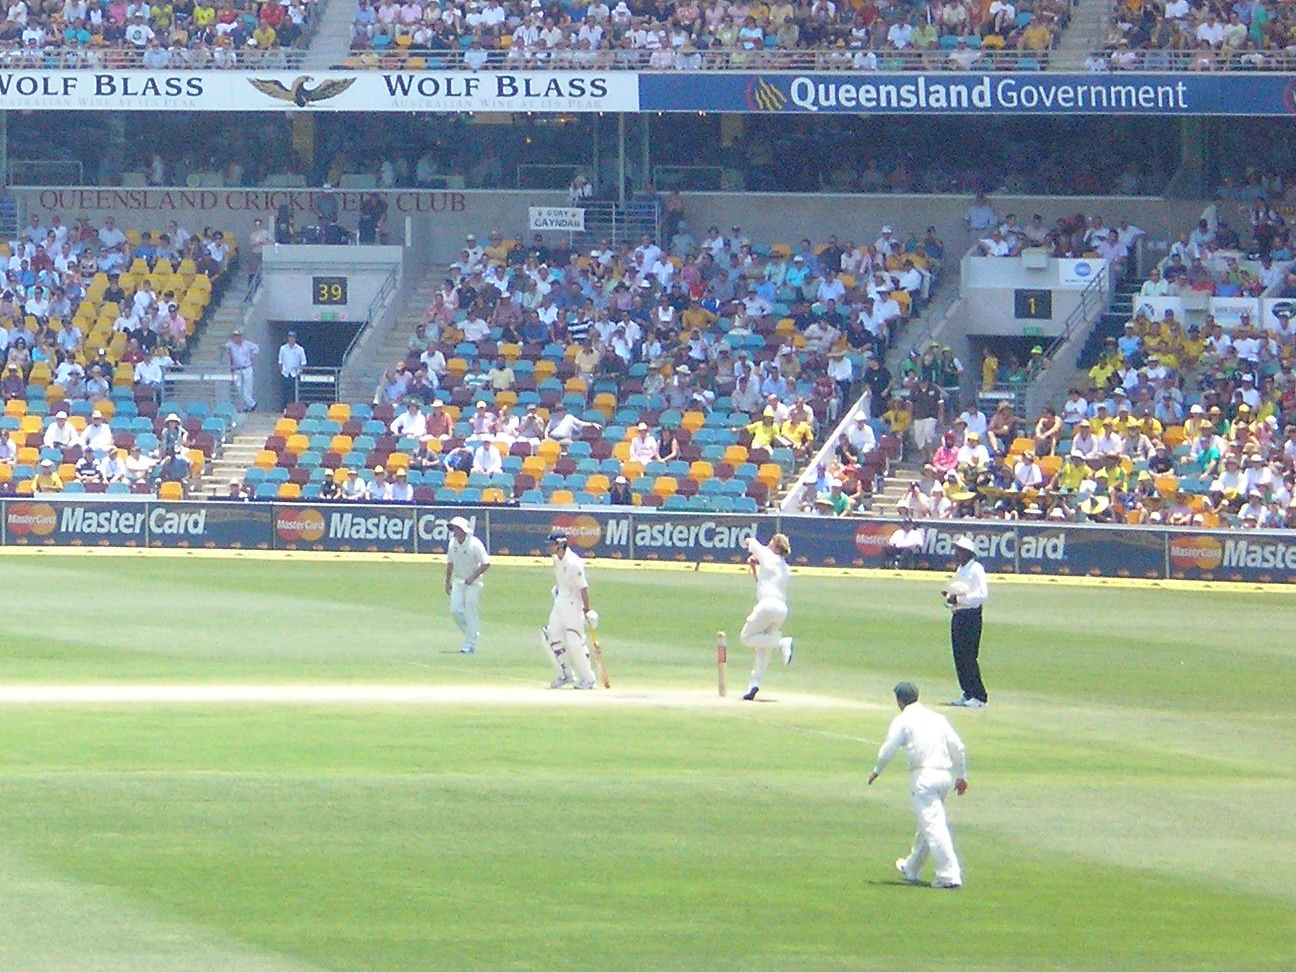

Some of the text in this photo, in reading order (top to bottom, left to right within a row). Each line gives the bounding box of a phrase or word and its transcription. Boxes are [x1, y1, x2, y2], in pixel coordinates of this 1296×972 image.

[94, 74, 204, 97] BLASS
[382, 74, 608, 98] WOLF BLASS
[790, 76, 1187, 111] Queensland Government
[39, 190, 218, 211] QUEENSLAND
[396, 192, 466, 213] CLUB
[319, 283, 342, 301] 39
[8, 514, 56, 525] MasterCard
[277, 519, 325, 531] MasterCard
